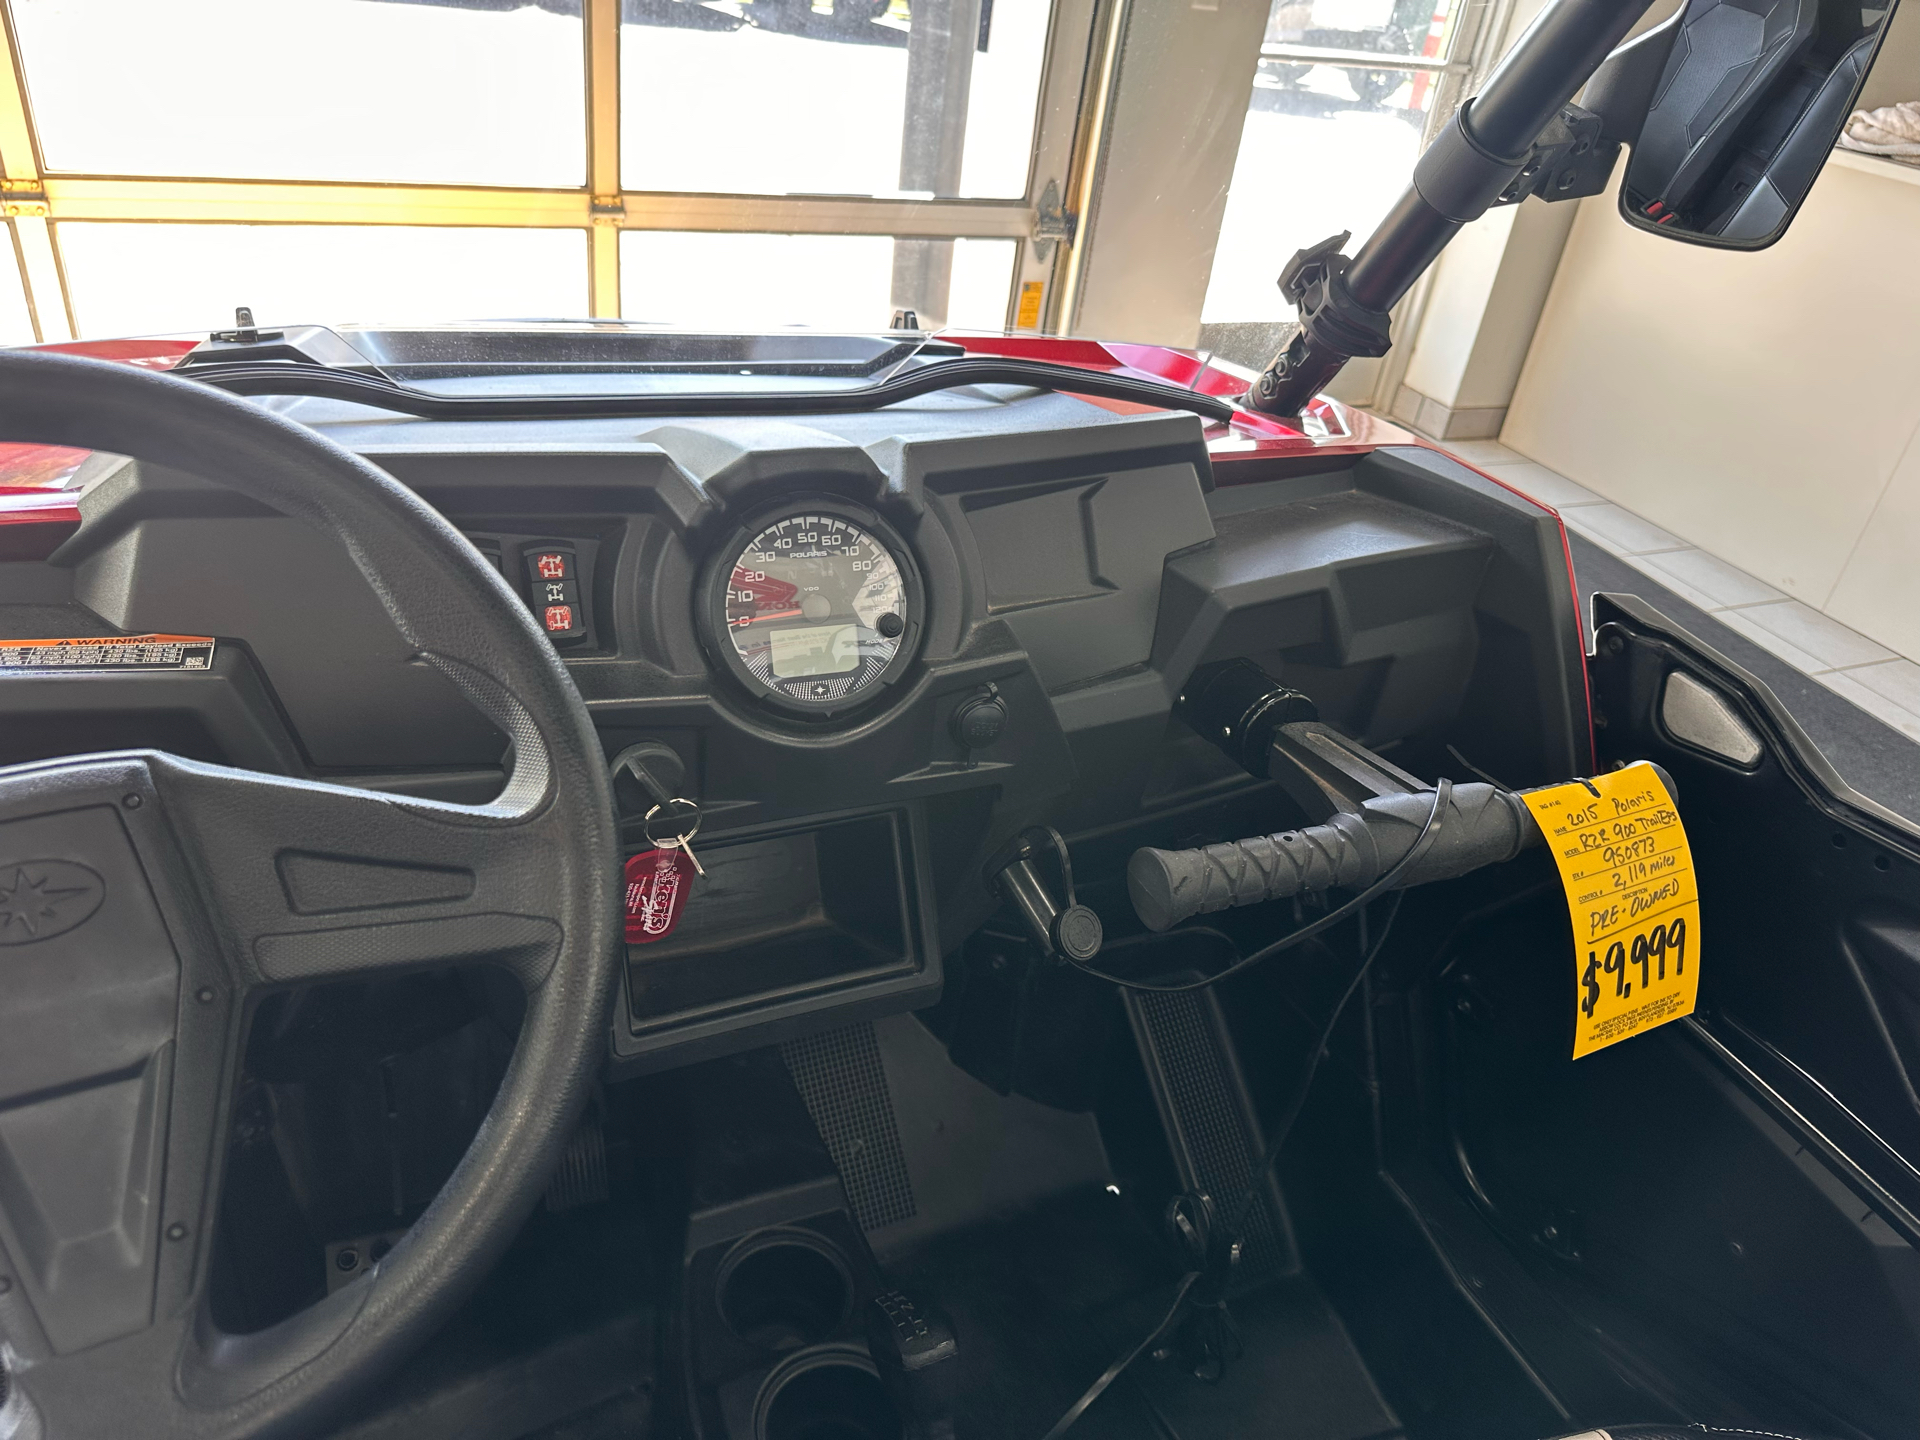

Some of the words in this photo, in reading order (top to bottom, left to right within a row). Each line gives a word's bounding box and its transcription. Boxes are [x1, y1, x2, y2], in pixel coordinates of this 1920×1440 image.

[797, 532, 818, 543] 50
[821, 535, 842, 545] 60
[773, 538, 793, 549] 40
[789, 550, 828, 559] POLARIS
[841, 545, 860, 556] 70
[755, 552, 776, 563] 30
[852, 560, 872, 572] 80
[744, 571, 766, 582] 20
[869, 583, 884, 591] 100
[738, 590, 754, 602] 10
[739, 616, 750, 627] 0
[77, 637, 157, 645] WARNING
[1566, 803, 1599, 826] 2015
[1611, 790, 1655, 817] Polaris
[1554, 826, 1568, 834] NAME
[1579, 828, 1610, 853] RZR
[1613, 822, 1637, 840] 900
[1564, 847, 1581, 857] MODEL
[1603, 836, 1655, 868] 950873
[1650, 855, 1675, 875] miles
[1578, 891, 1598, 903] CONTROL
[1622, 887, 1648, 901] DESCRIPTION
[1581, 917, 1687, 1020] $9,999
